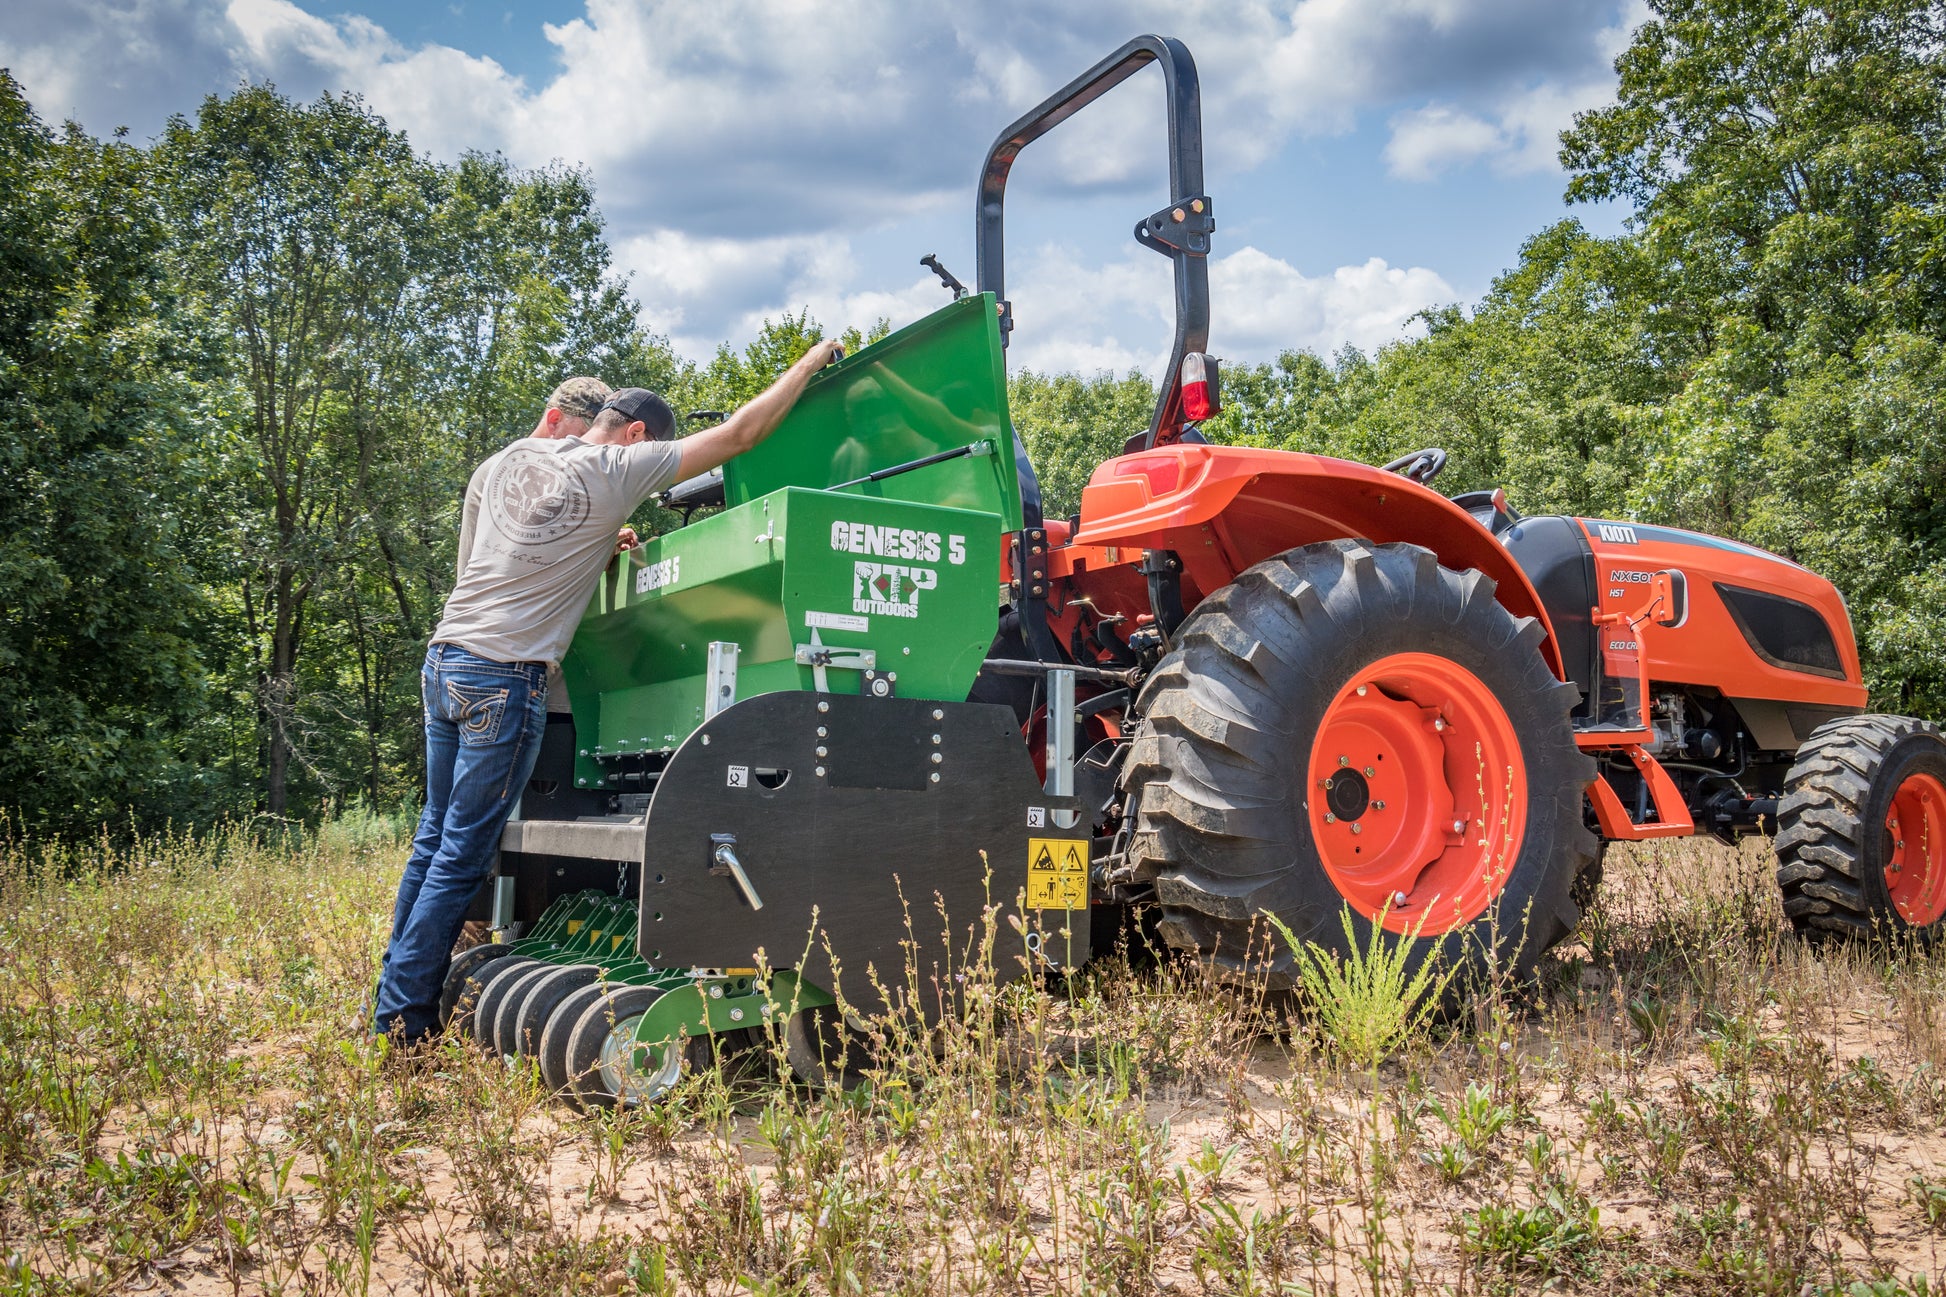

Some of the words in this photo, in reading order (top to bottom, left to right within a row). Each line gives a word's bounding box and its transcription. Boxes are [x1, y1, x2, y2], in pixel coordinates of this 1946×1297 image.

[570, 492, 580, 520] FAMILY
[504, 523, 542, 539] FREEDOM
[1598, 525, 1638, 544] KIOTI
[830, 520, 942, 563] GENESIS
[948, 534, 966, 565] 5
[636, 558, 671, 595] GENESIS
[672, 555, 680, 583] 5
[1609, 589, 1625, 597] HST
[852, 598, 919, 619] OUTDOORS
[1609, 641, 1626, 650] ECO
